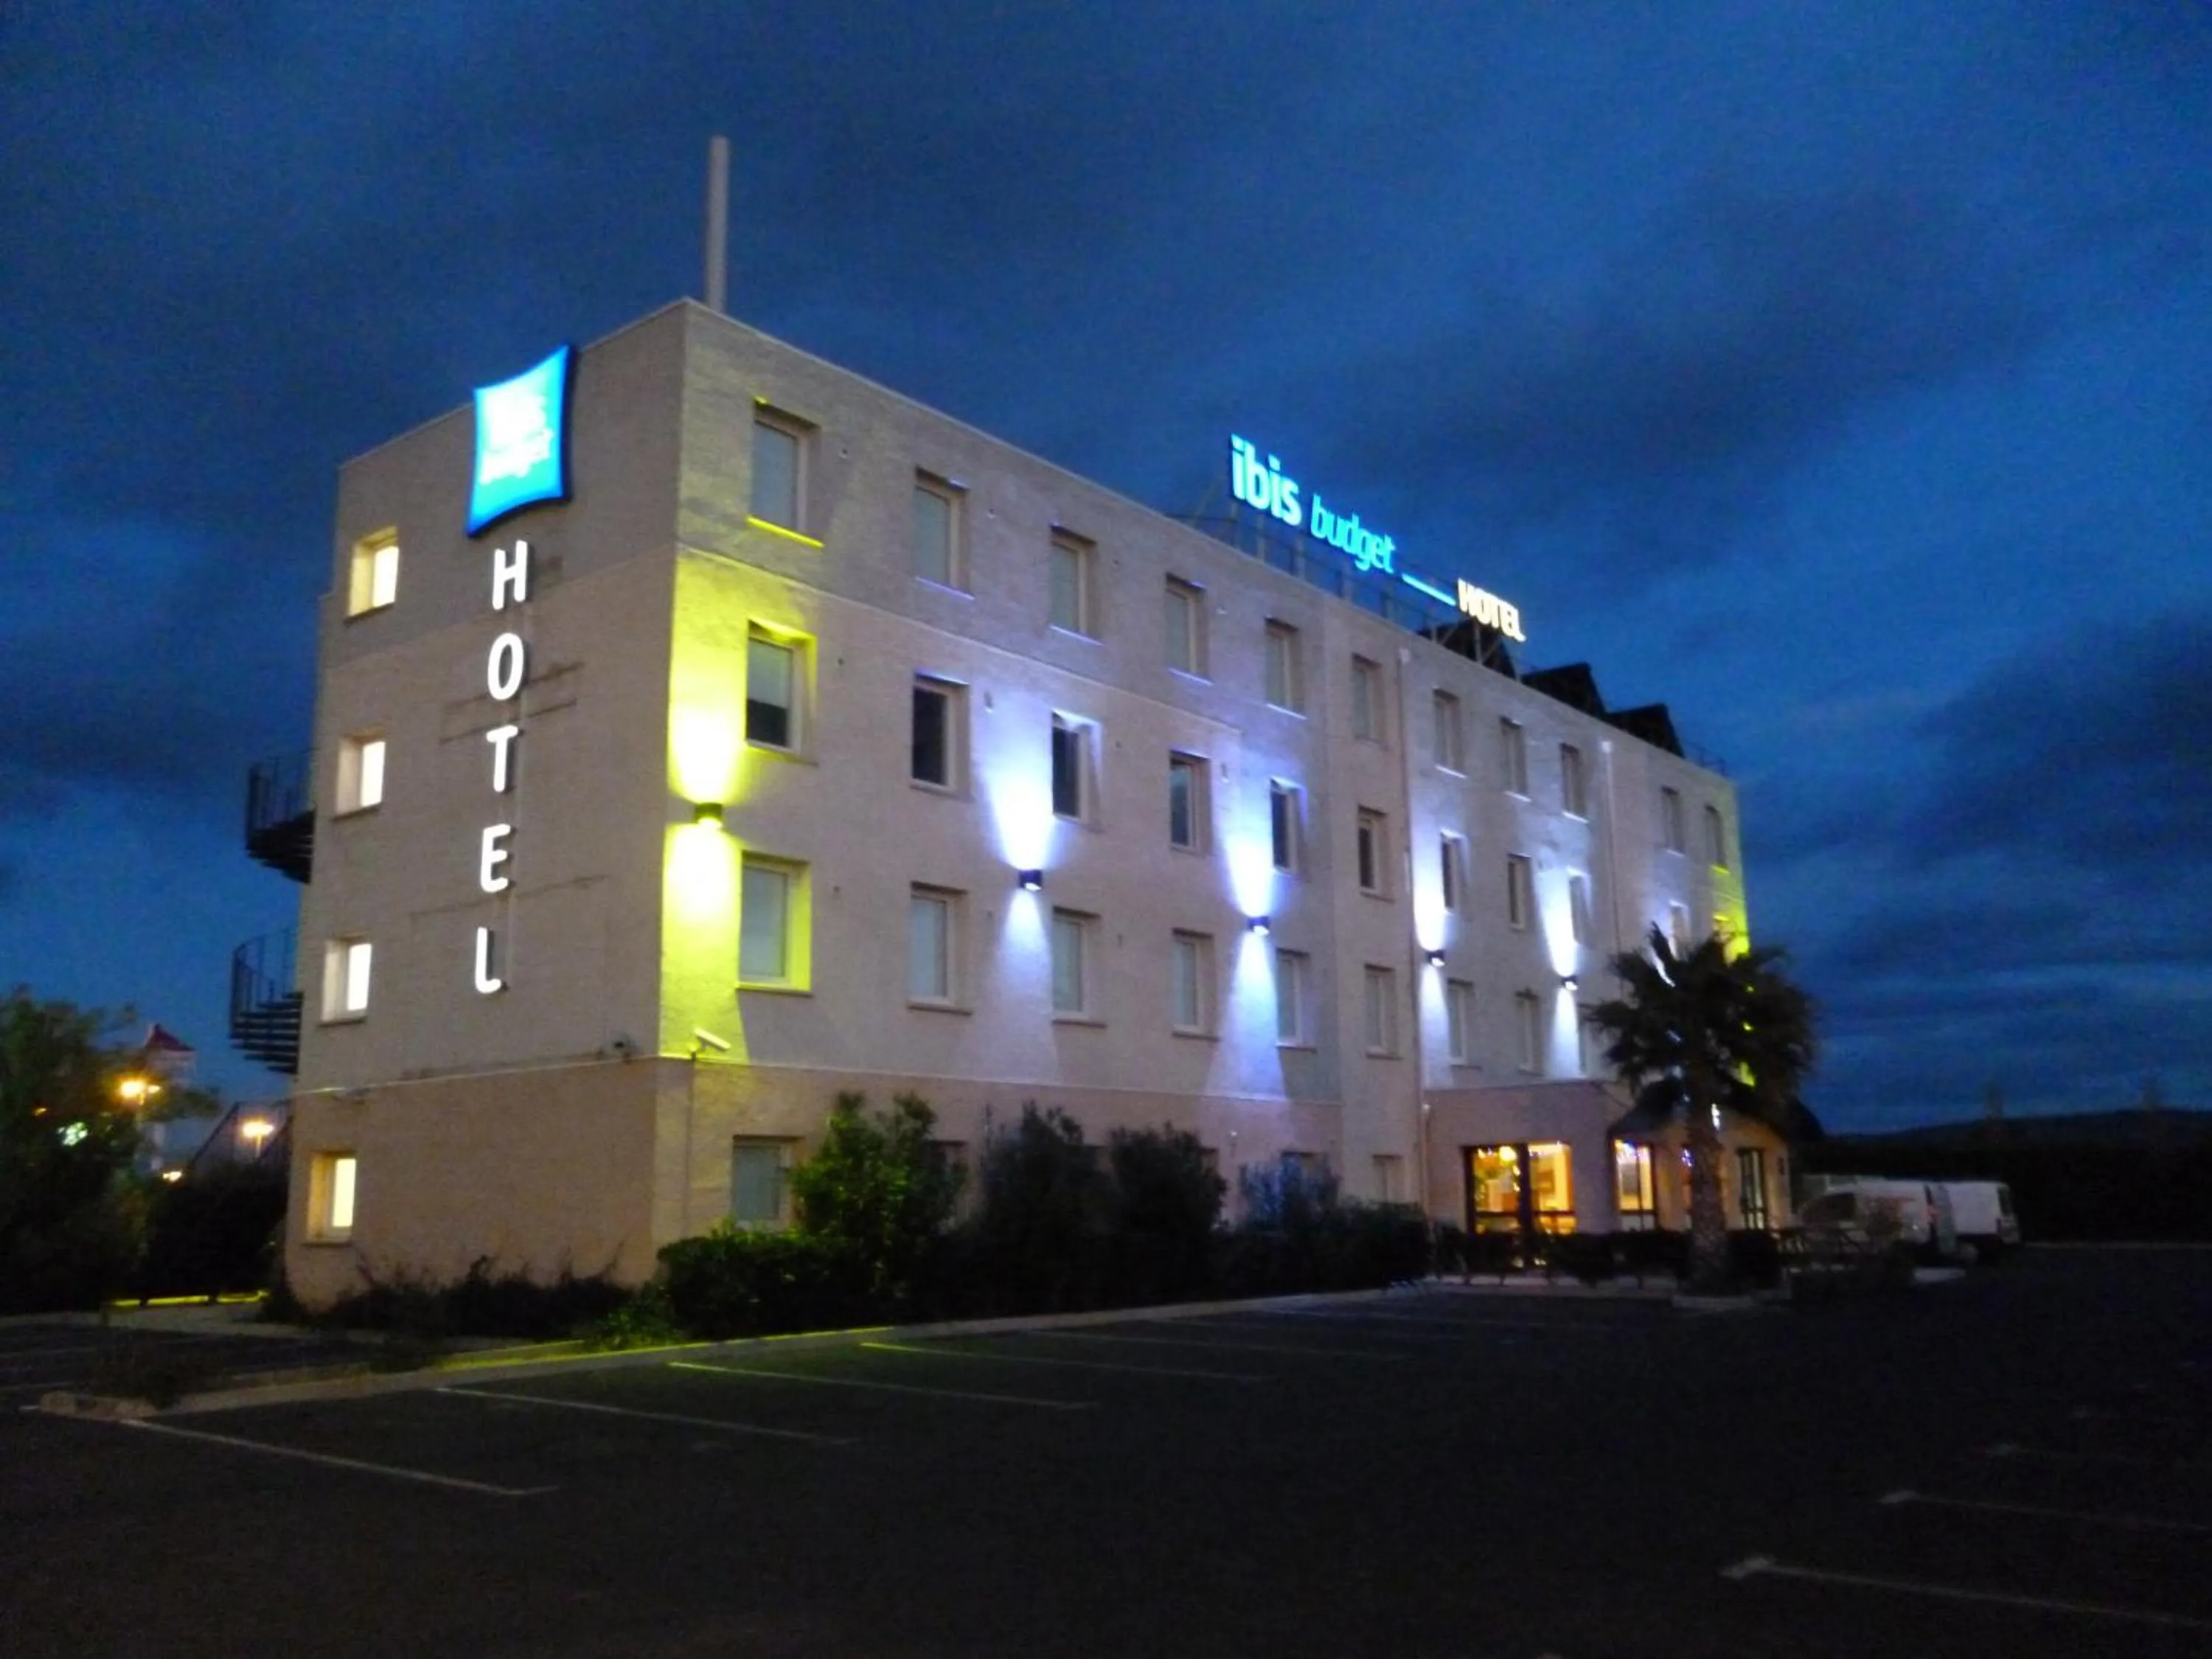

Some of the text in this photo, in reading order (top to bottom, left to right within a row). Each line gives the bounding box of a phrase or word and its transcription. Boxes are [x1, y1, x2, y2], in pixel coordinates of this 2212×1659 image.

[1231, 433, 1526, 642] ibis budget HOTEL
[474, 540, 529, 994] HOTEL
